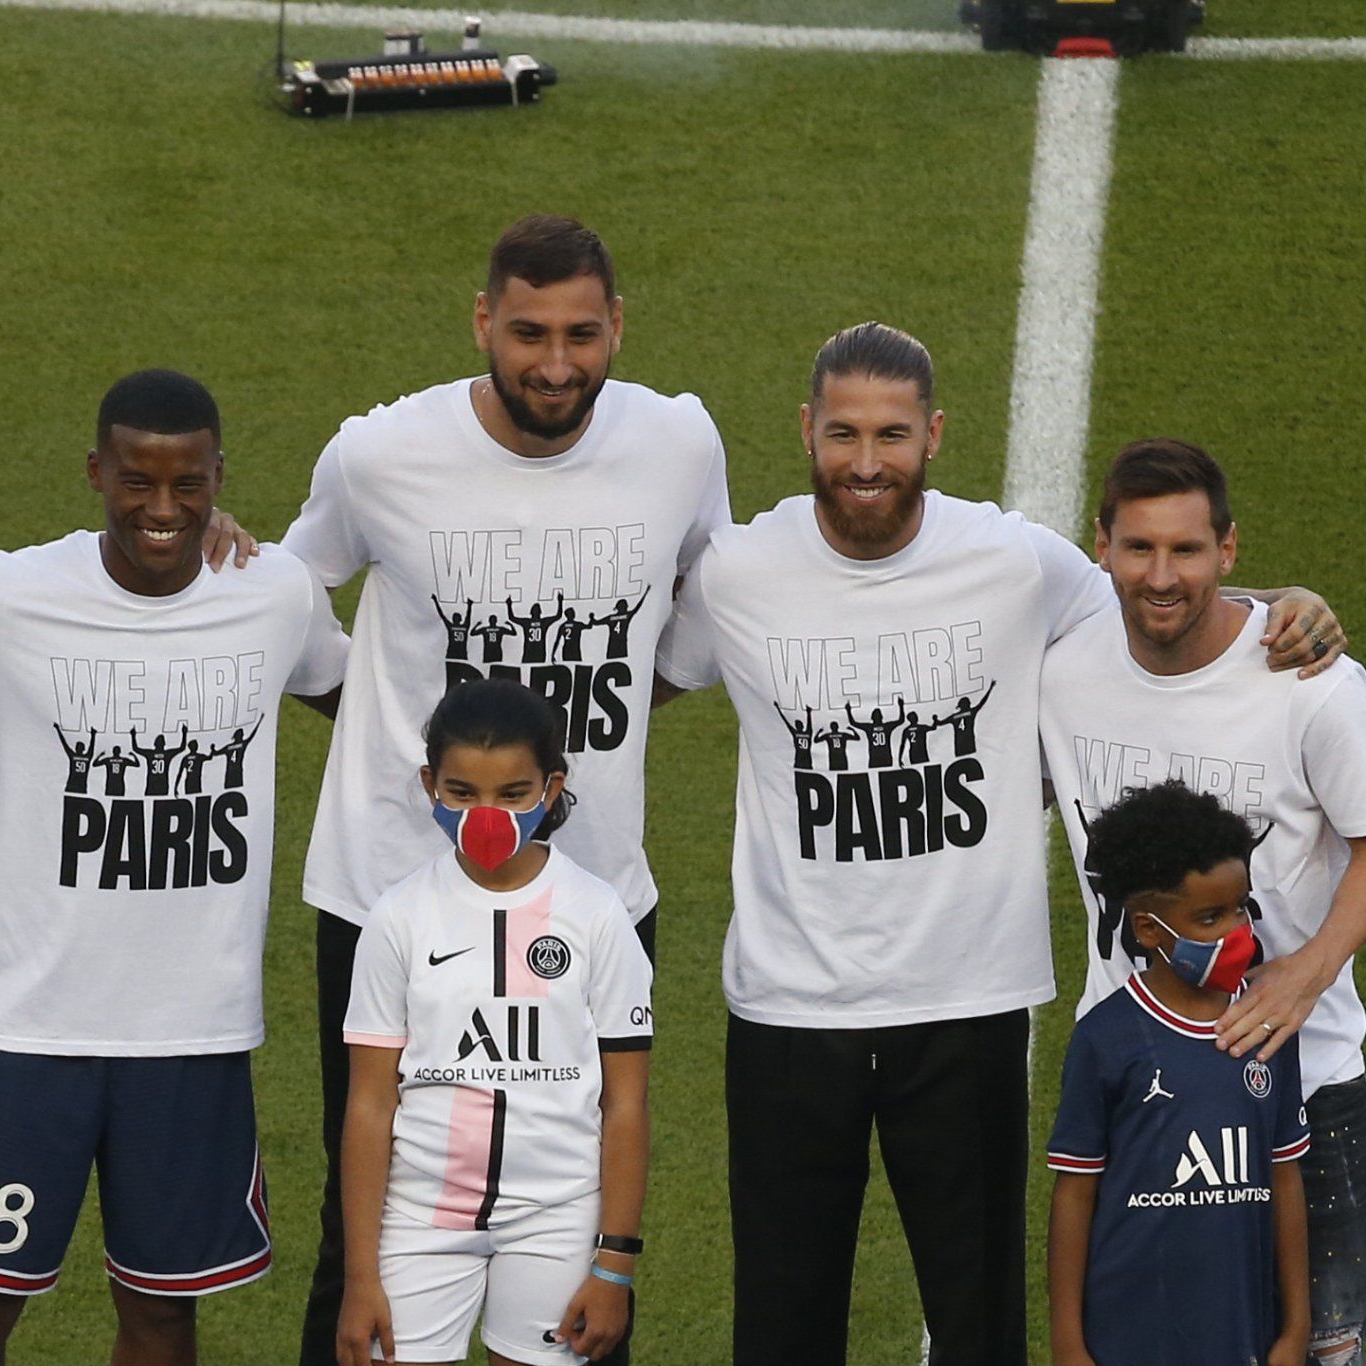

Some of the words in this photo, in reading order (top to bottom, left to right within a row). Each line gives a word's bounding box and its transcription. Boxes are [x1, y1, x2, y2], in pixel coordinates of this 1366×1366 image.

[429, 530, 522, 603] WE
[538, 523, 644, 601] ARE
[528, 628, 542, 642] 30
[565, 628, 572, 640] 2
[767, 637, 861, 710] WE
[878, 620, 984, 706] ARE
[50, 657, 147, 733] WE
[162, 651, 264, 733] ARE
[872, 732, 886, 746] 30
[910, 731, 917, 743] 2
[75, 761, 86, 773] 50
[151, 759, 165, 775] 30
[187, 760, 194, 772] 2
[794, 757, 988, 862] PARIS
[59, 791, 248, 890] PARIS
[414, 1068, 466, 1081] ACCOR
[471, 1068, 506, 1081] LIVE
[511, 1067, 580, 1081] LIMITLESS
[1127, 1192, 1186, 1207] ACCOR
[1190, 1190, 1225, 1205] LIVE
